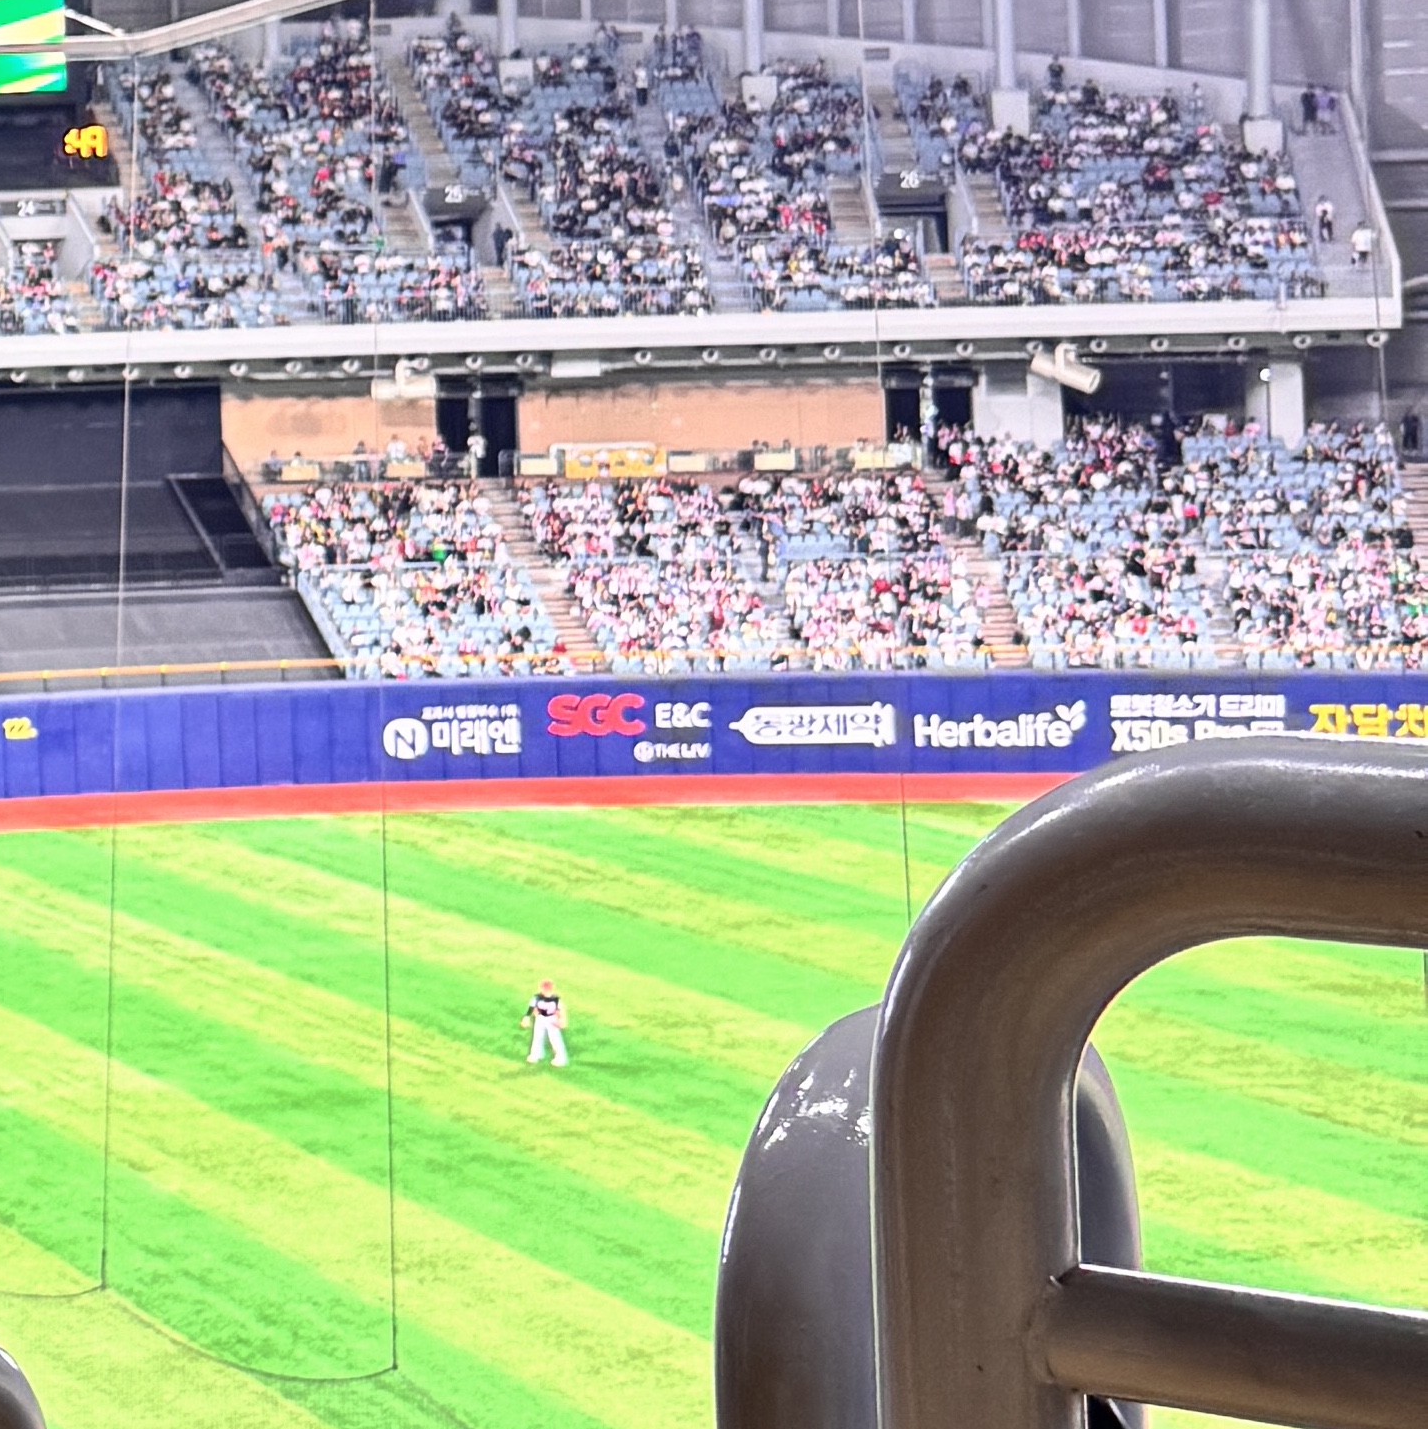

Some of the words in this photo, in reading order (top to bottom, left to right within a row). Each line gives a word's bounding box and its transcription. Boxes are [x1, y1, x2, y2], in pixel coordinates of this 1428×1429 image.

[900, 171, 920, 189] 26
[547, 693, 646, 737] SGC
[655, 702, 712, 729] E&C
[913, 712, 1073, 748] Herbalife
[431, 717, 522, 756] 미래엔
